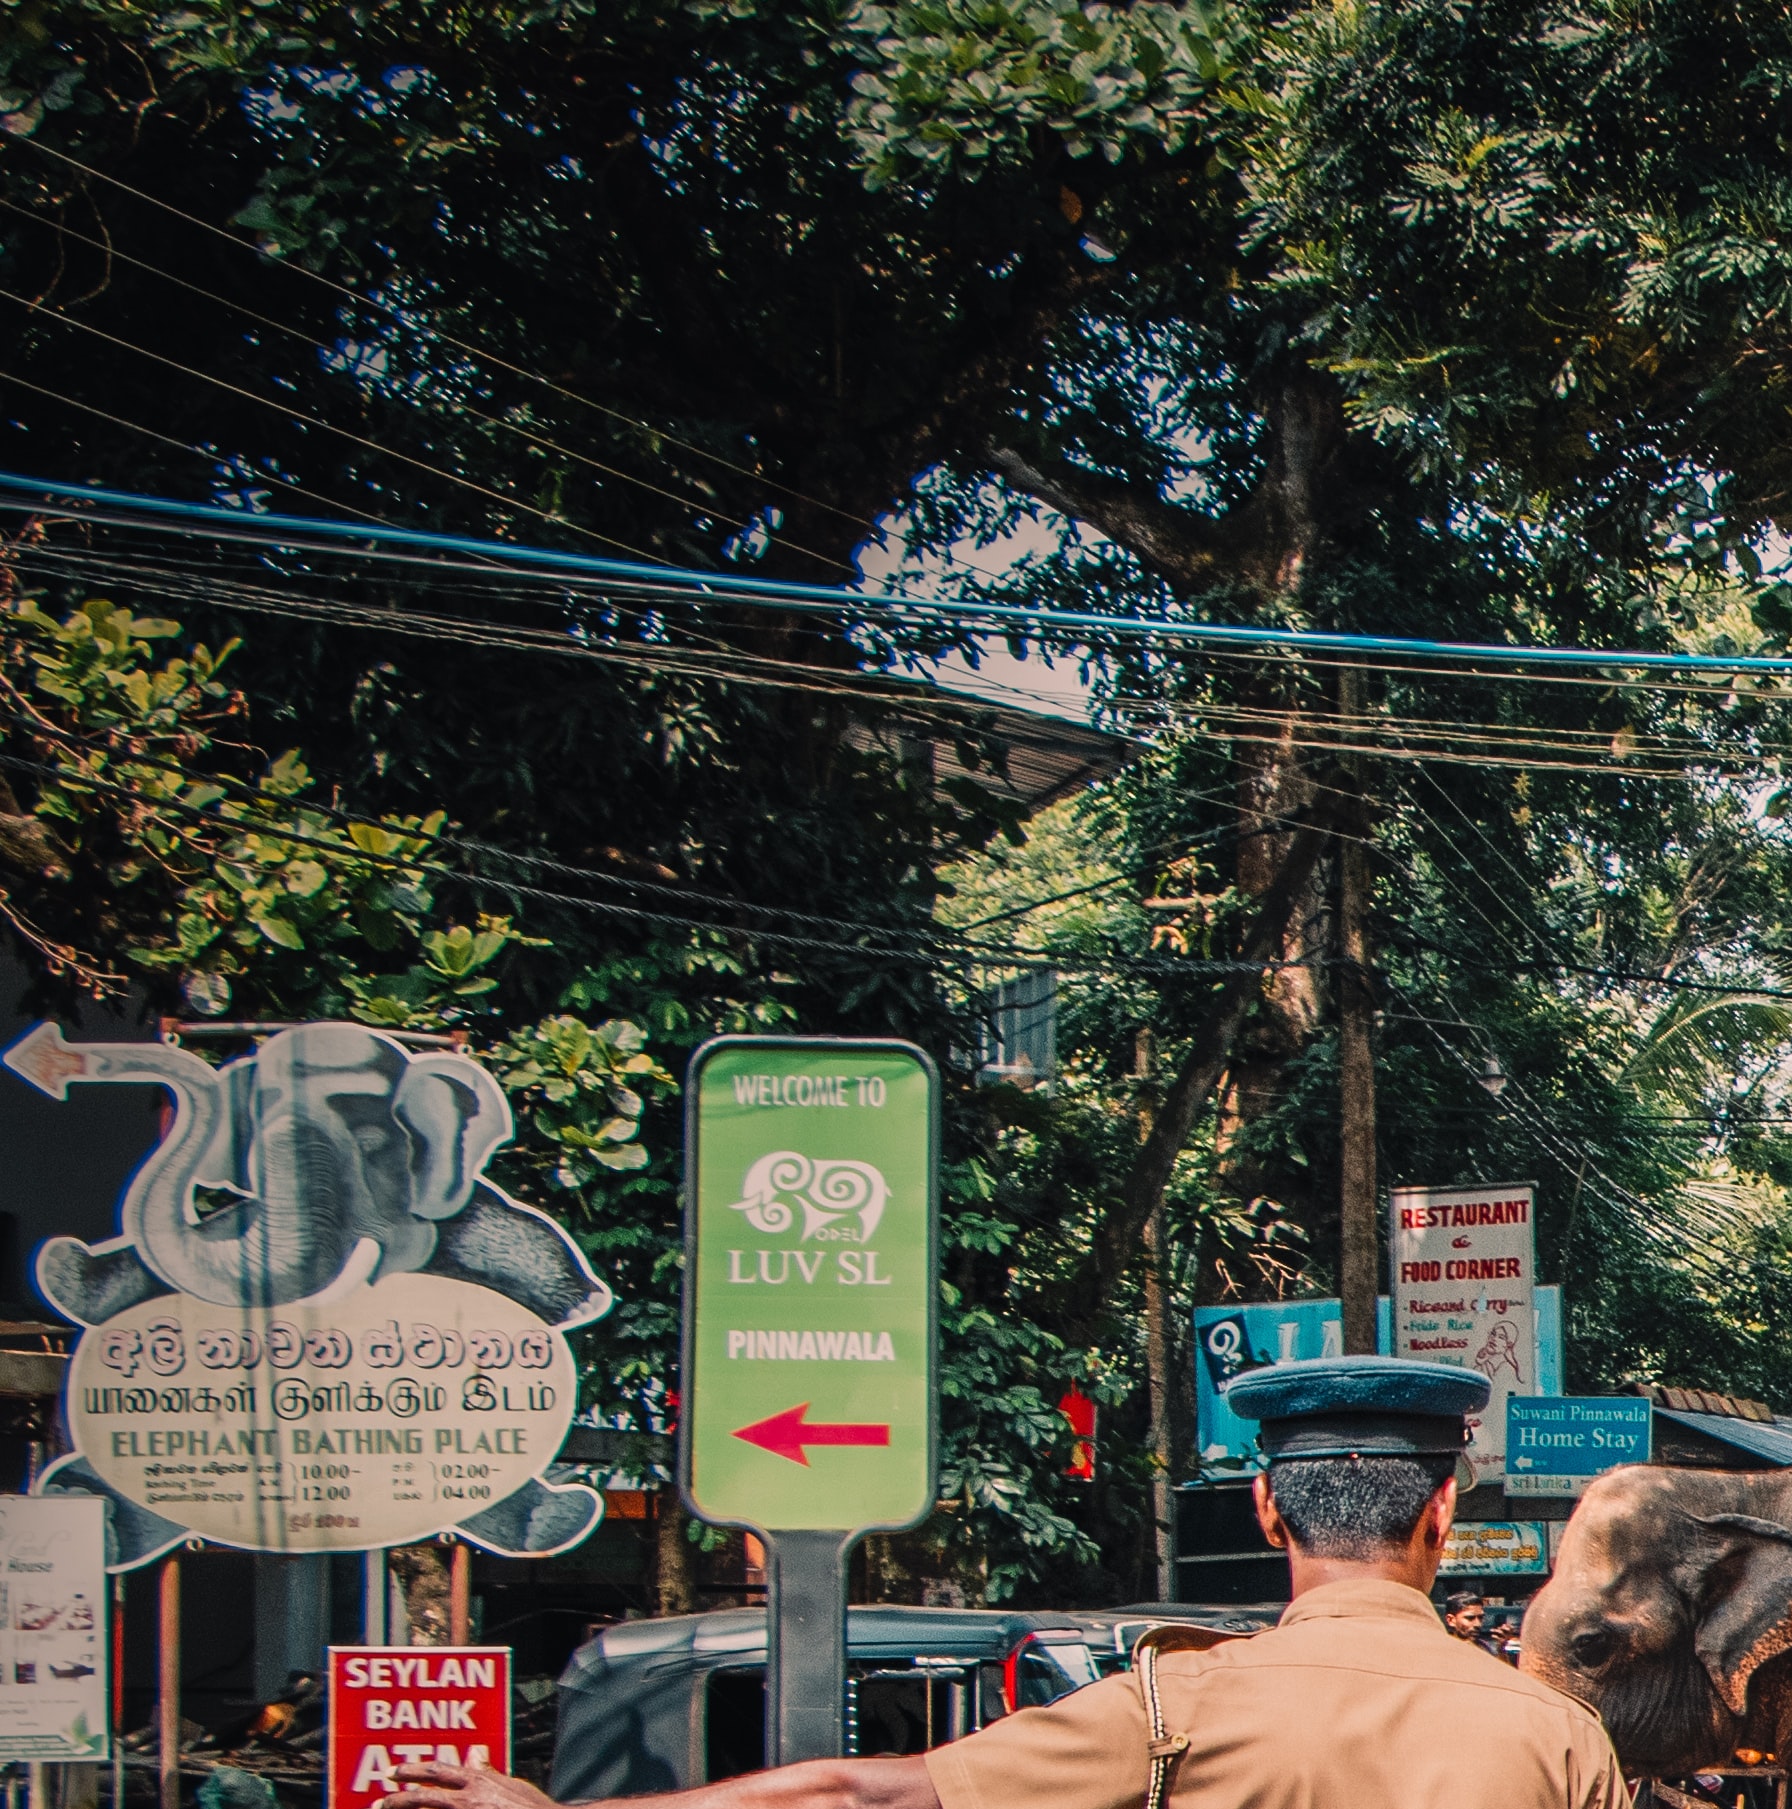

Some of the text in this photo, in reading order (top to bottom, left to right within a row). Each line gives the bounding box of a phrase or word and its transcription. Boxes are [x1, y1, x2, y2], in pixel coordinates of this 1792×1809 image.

[733, 1074, 887, 1107] WELCOME TO
[1401, 1200, 1529, 1230] RESTAURANT
[727, 1250, 892, 1285] LUV SL
[1401, 1257, 1521, 1284] FOOD CORNER
[100, 1316, 553, 1378] අලි නාවන ස්ථානය
[727, 1329, 896, 1362] PINNAWALA
[462, 1373, 556, 1412] இடம்
[1511, 1403, 1647, 1423] Suwani Pinnawala
[111, 1427, 528, 1457] ELEPHANT BATHING PLACE
[1519, 1427, 1640, 1454] Home Stay
[345, 1658, 496, 1689] SEYLAN
[366, 1699, 477, 1730] BANK
